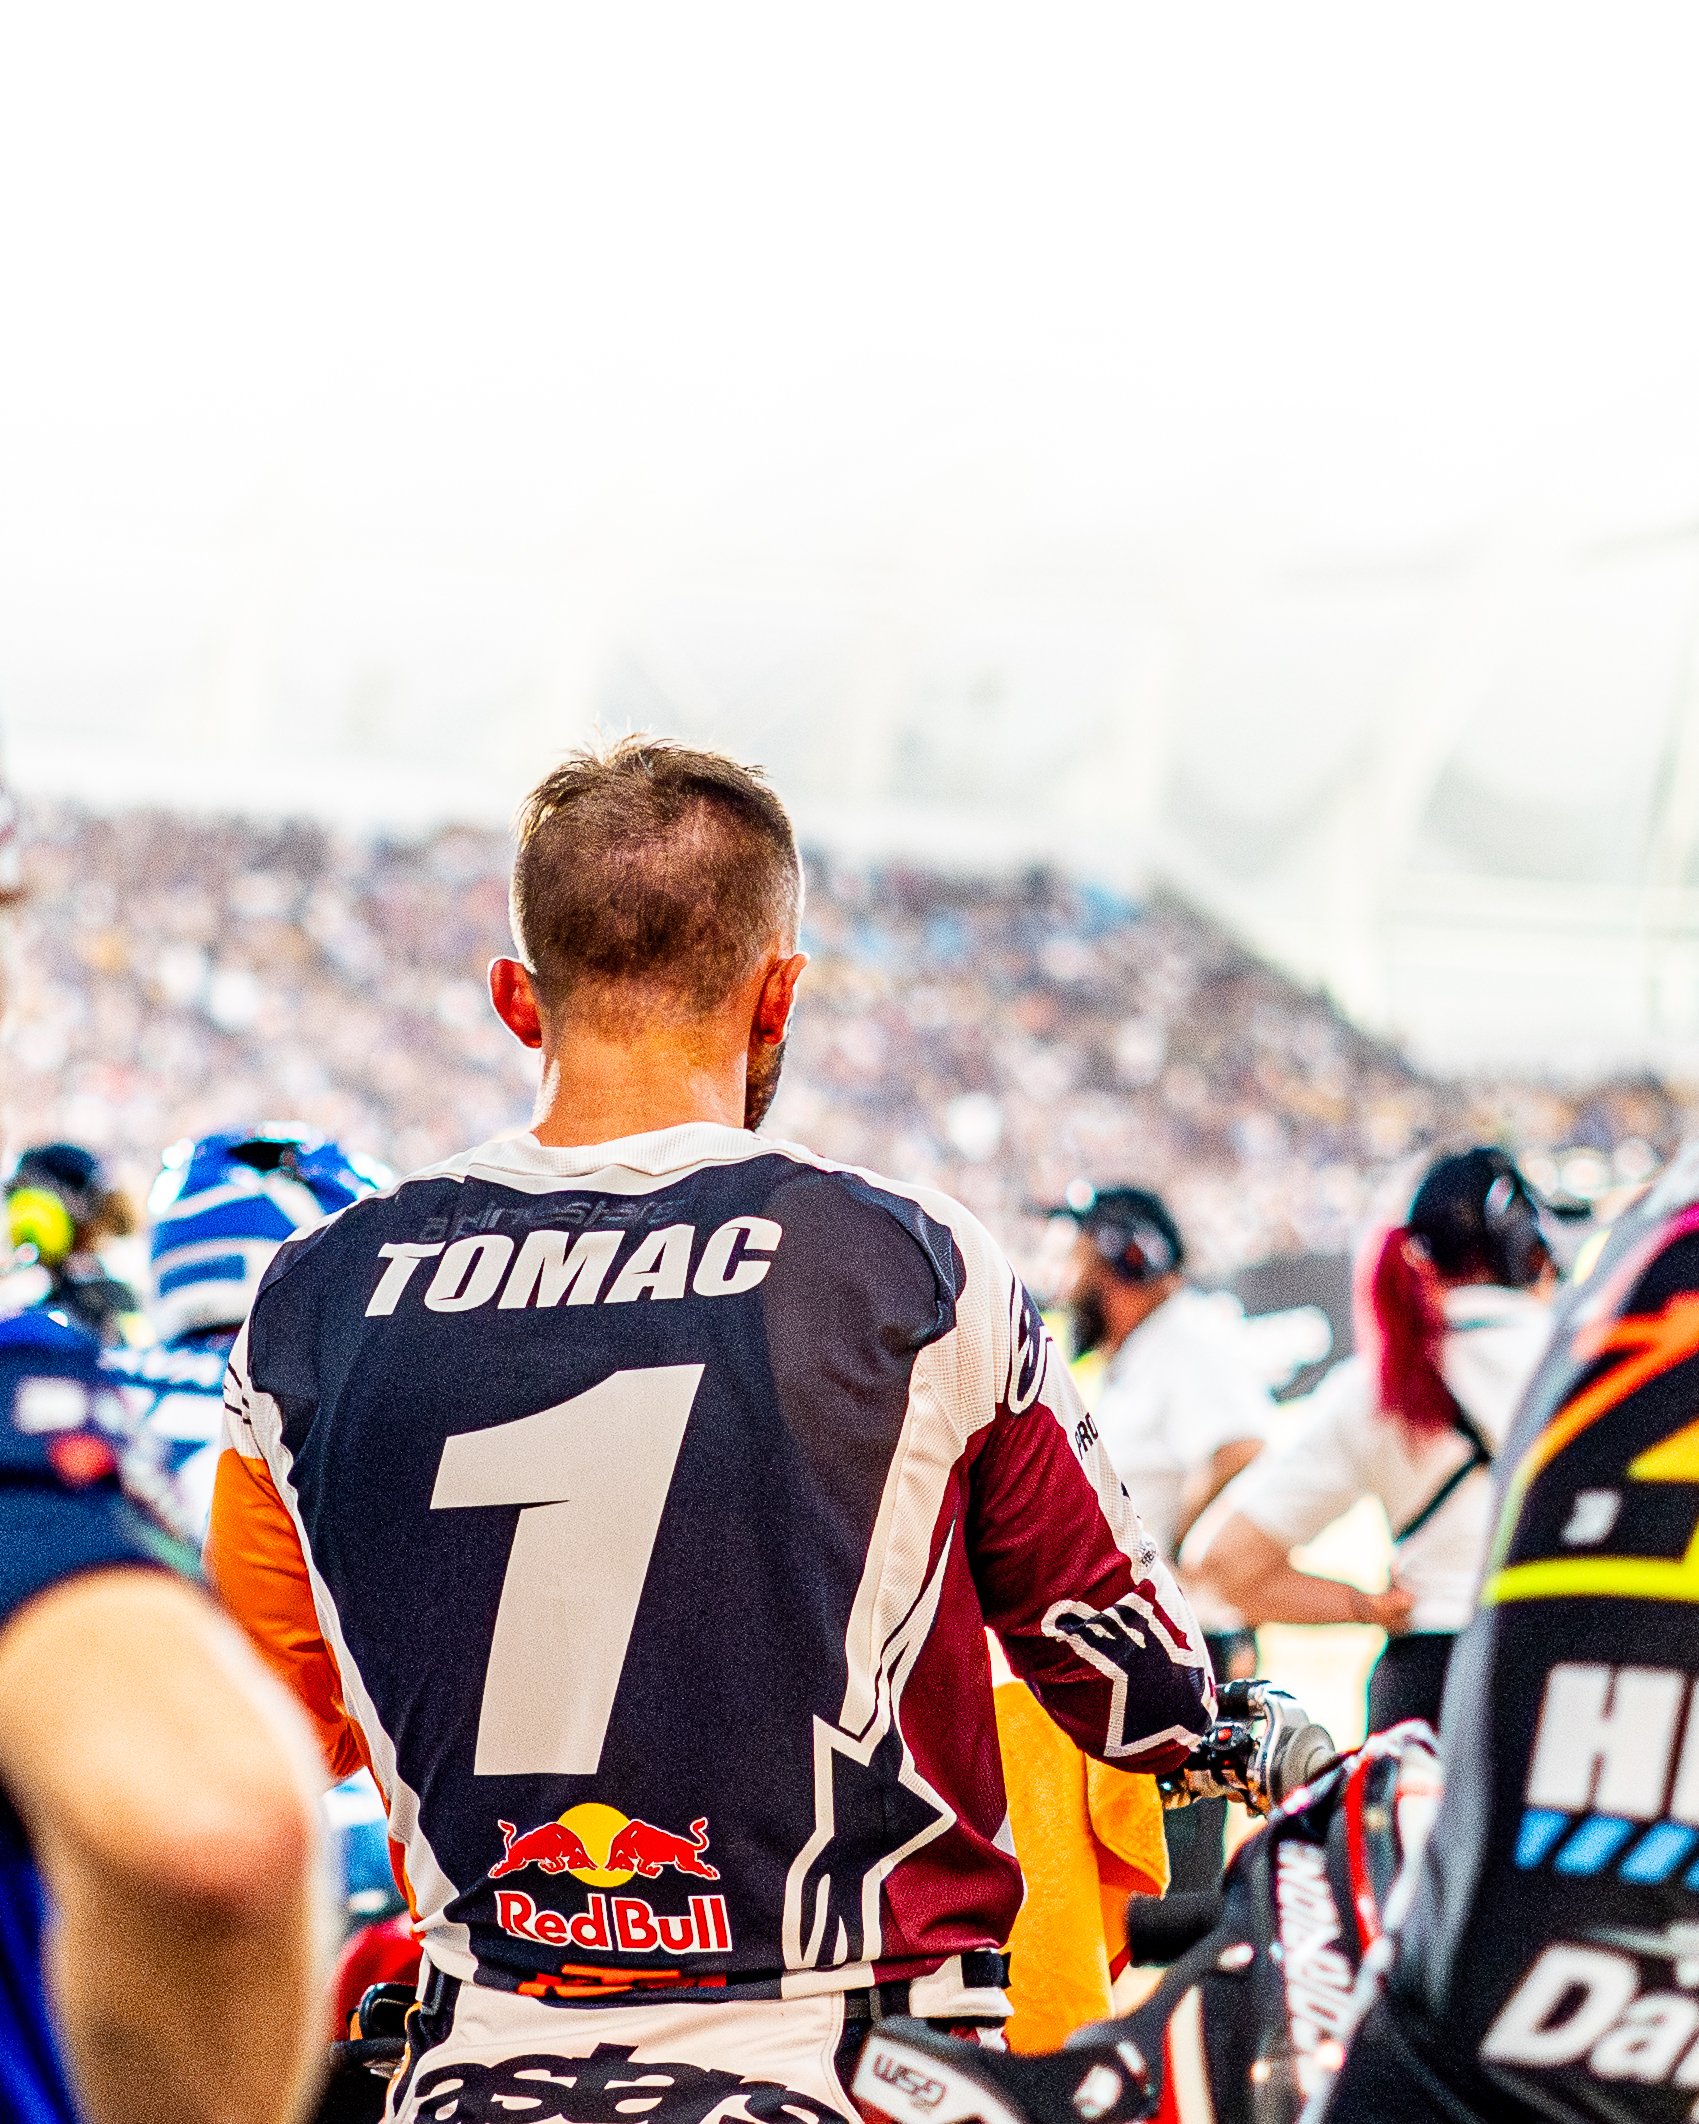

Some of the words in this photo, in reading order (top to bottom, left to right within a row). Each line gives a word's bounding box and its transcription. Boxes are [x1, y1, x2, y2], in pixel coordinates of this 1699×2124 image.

[364, 1216, 783, 1318] TOMAC
[430, 1364, 705, 1776] 1
[494, 1890, 613, 1951] Red
[611, 1894, 733, 1955] Bull
